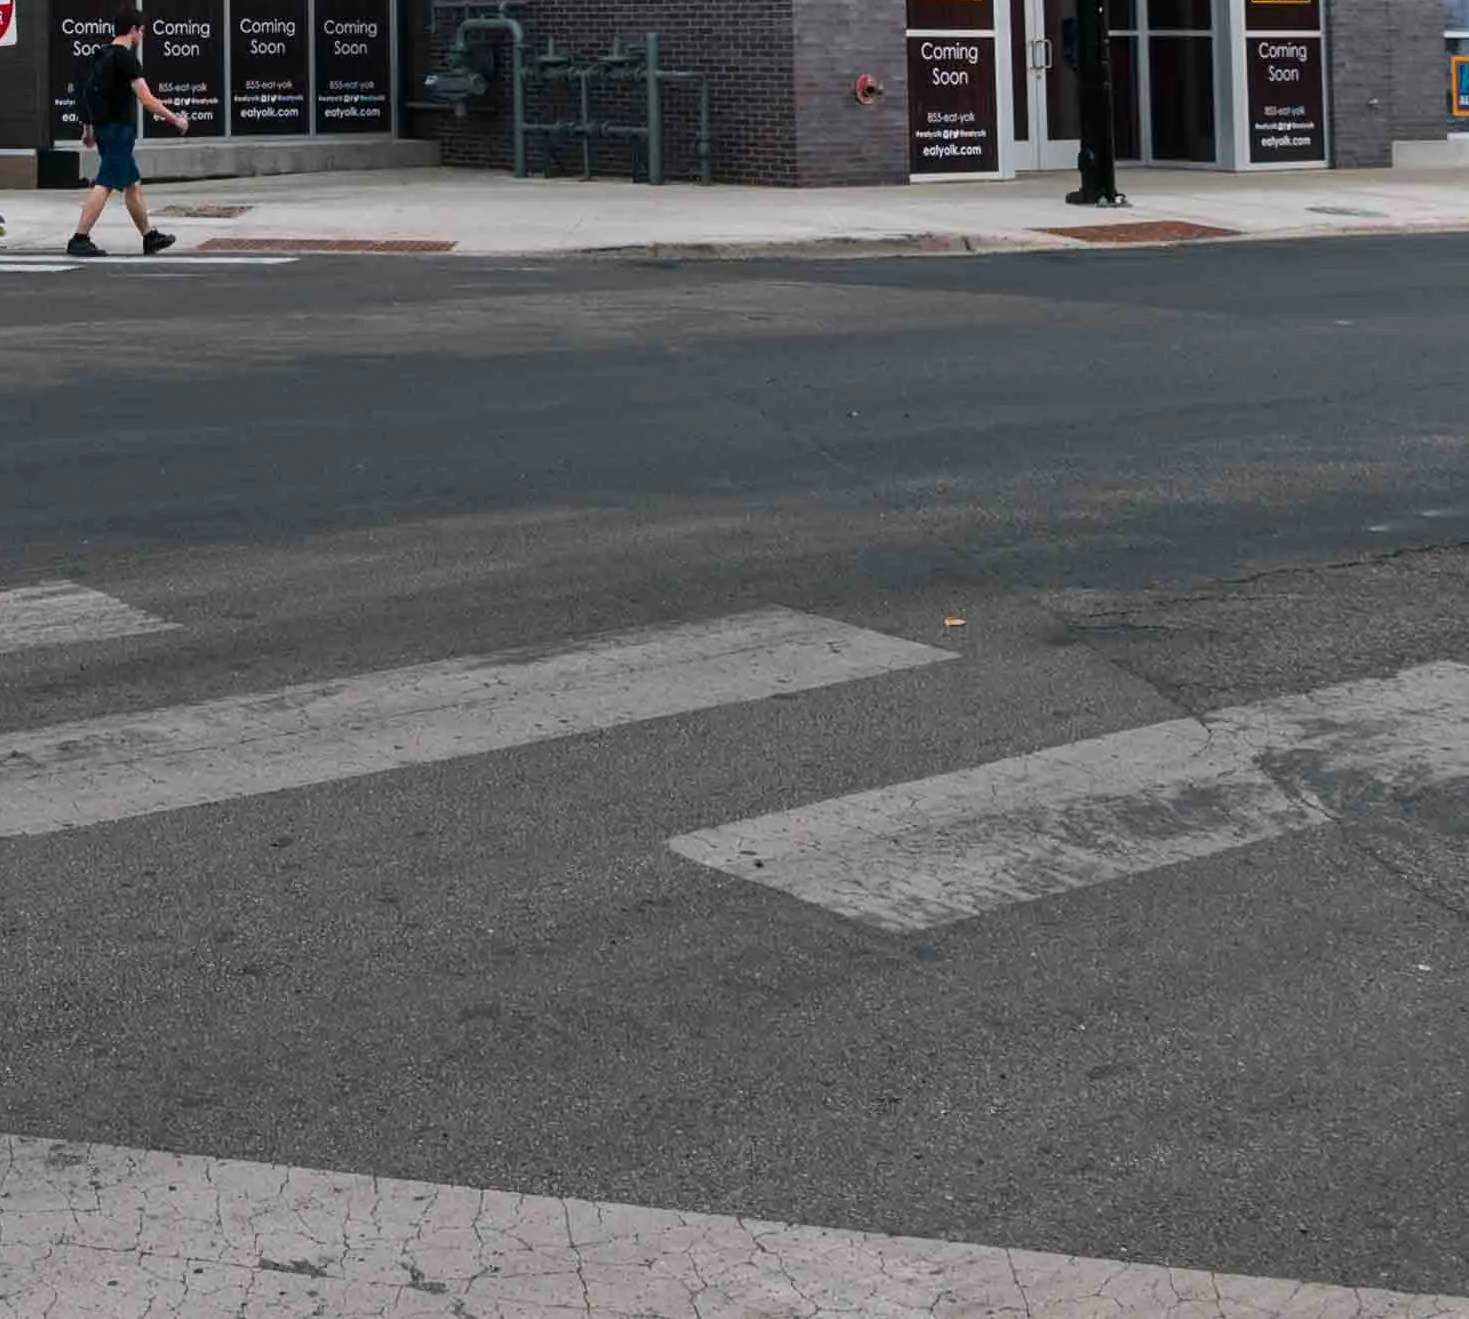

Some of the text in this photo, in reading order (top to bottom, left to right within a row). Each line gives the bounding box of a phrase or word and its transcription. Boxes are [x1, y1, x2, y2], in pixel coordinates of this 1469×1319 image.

[62, 18, 115, 35] Comin
[153, 19, 211, 38] Coming
[239, 18, 295, 37] Coming
[324, 20, 378, 37] Coming
[73, 40, 102, 56] Soo
[164, 40, 200, 56] Soon
[250, 40, 286, 55] Soon
[334, 41, 367, 55] Soon
[921, 42, 979, 64] Coming
[1258, 42, 1308, 62] Coming
[932, 67, 968, 85] Soon
[1268, 66, 1299, 82] Soon
[240, 107, 299, 119] eatyolk.com
[324, 107, 380, 119] eatyolk.com
[1261, 136, 1311, 149] eatyolk.com
[923, 144, 982, 159] eatyolk.com
